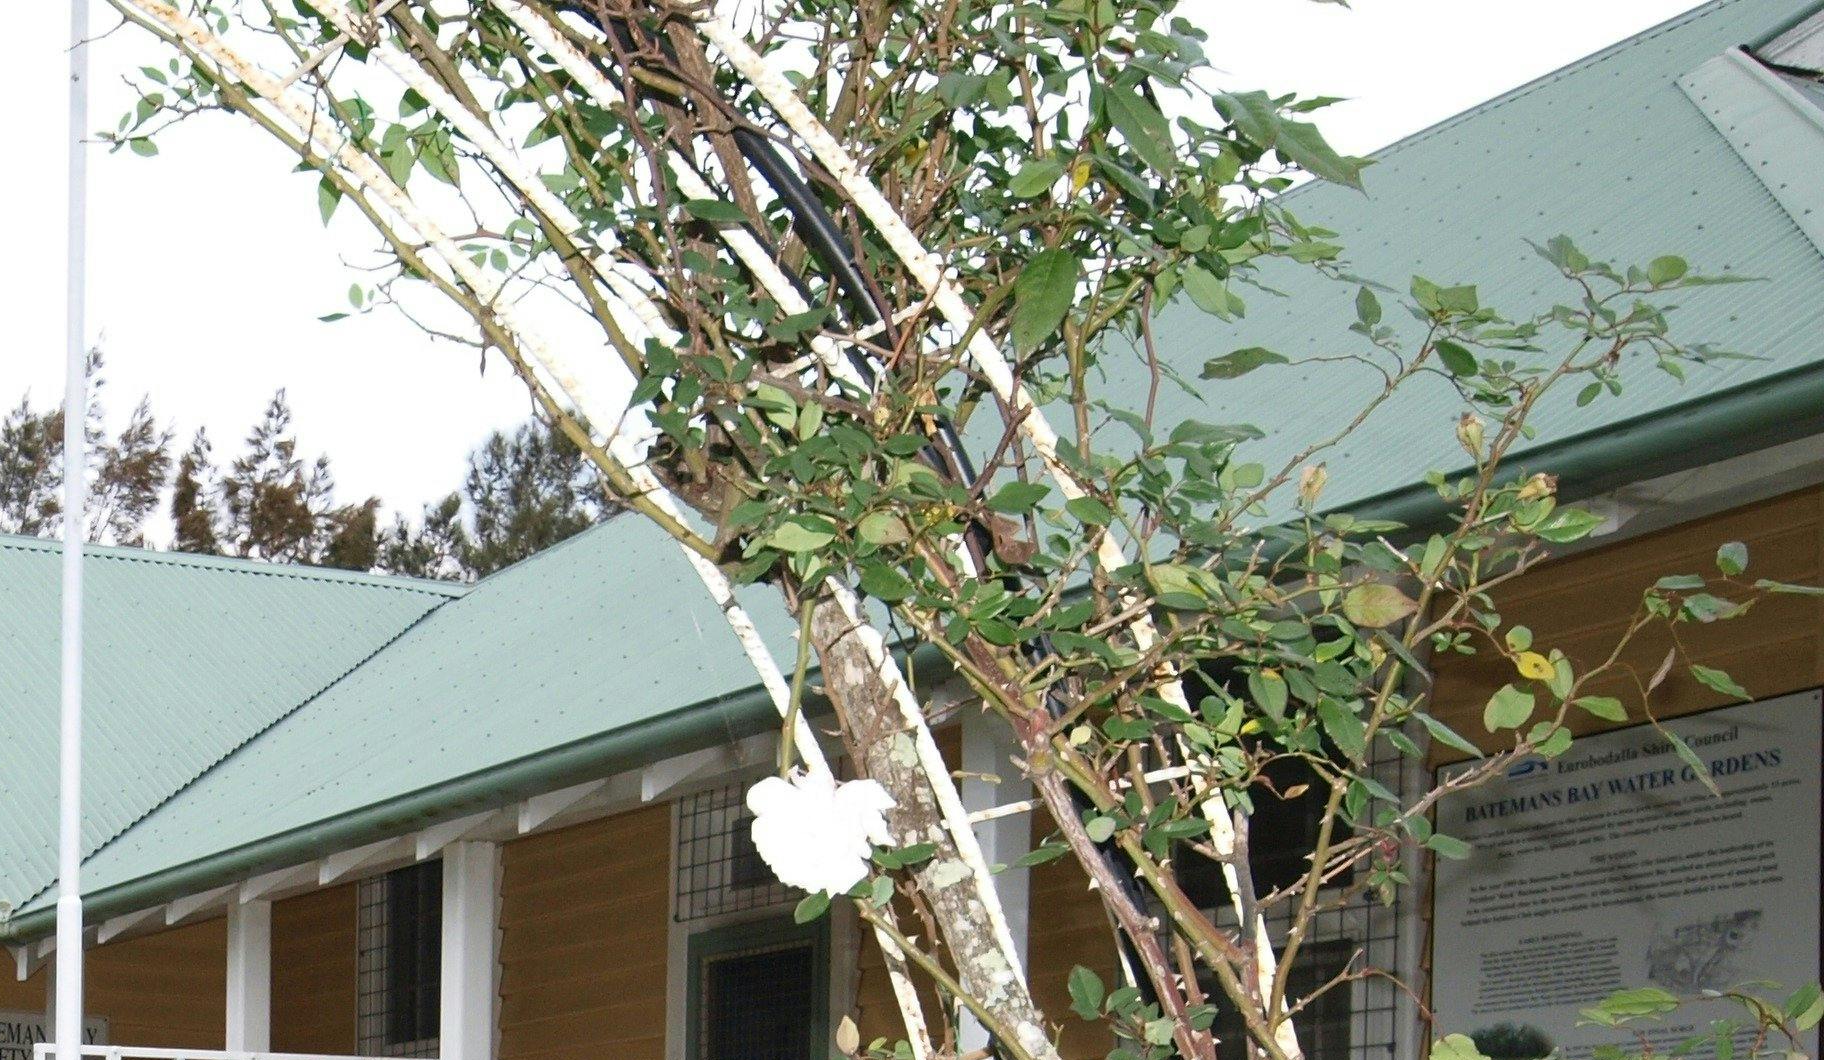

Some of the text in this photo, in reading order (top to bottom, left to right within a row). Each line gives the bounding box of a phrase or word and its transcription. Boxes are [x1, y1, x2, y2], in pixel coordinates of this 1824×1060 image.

[1684, 726, 1738, 748] Council
[1465, 748, 1782, 822] BATEMANS BAY WATER GRDENS
